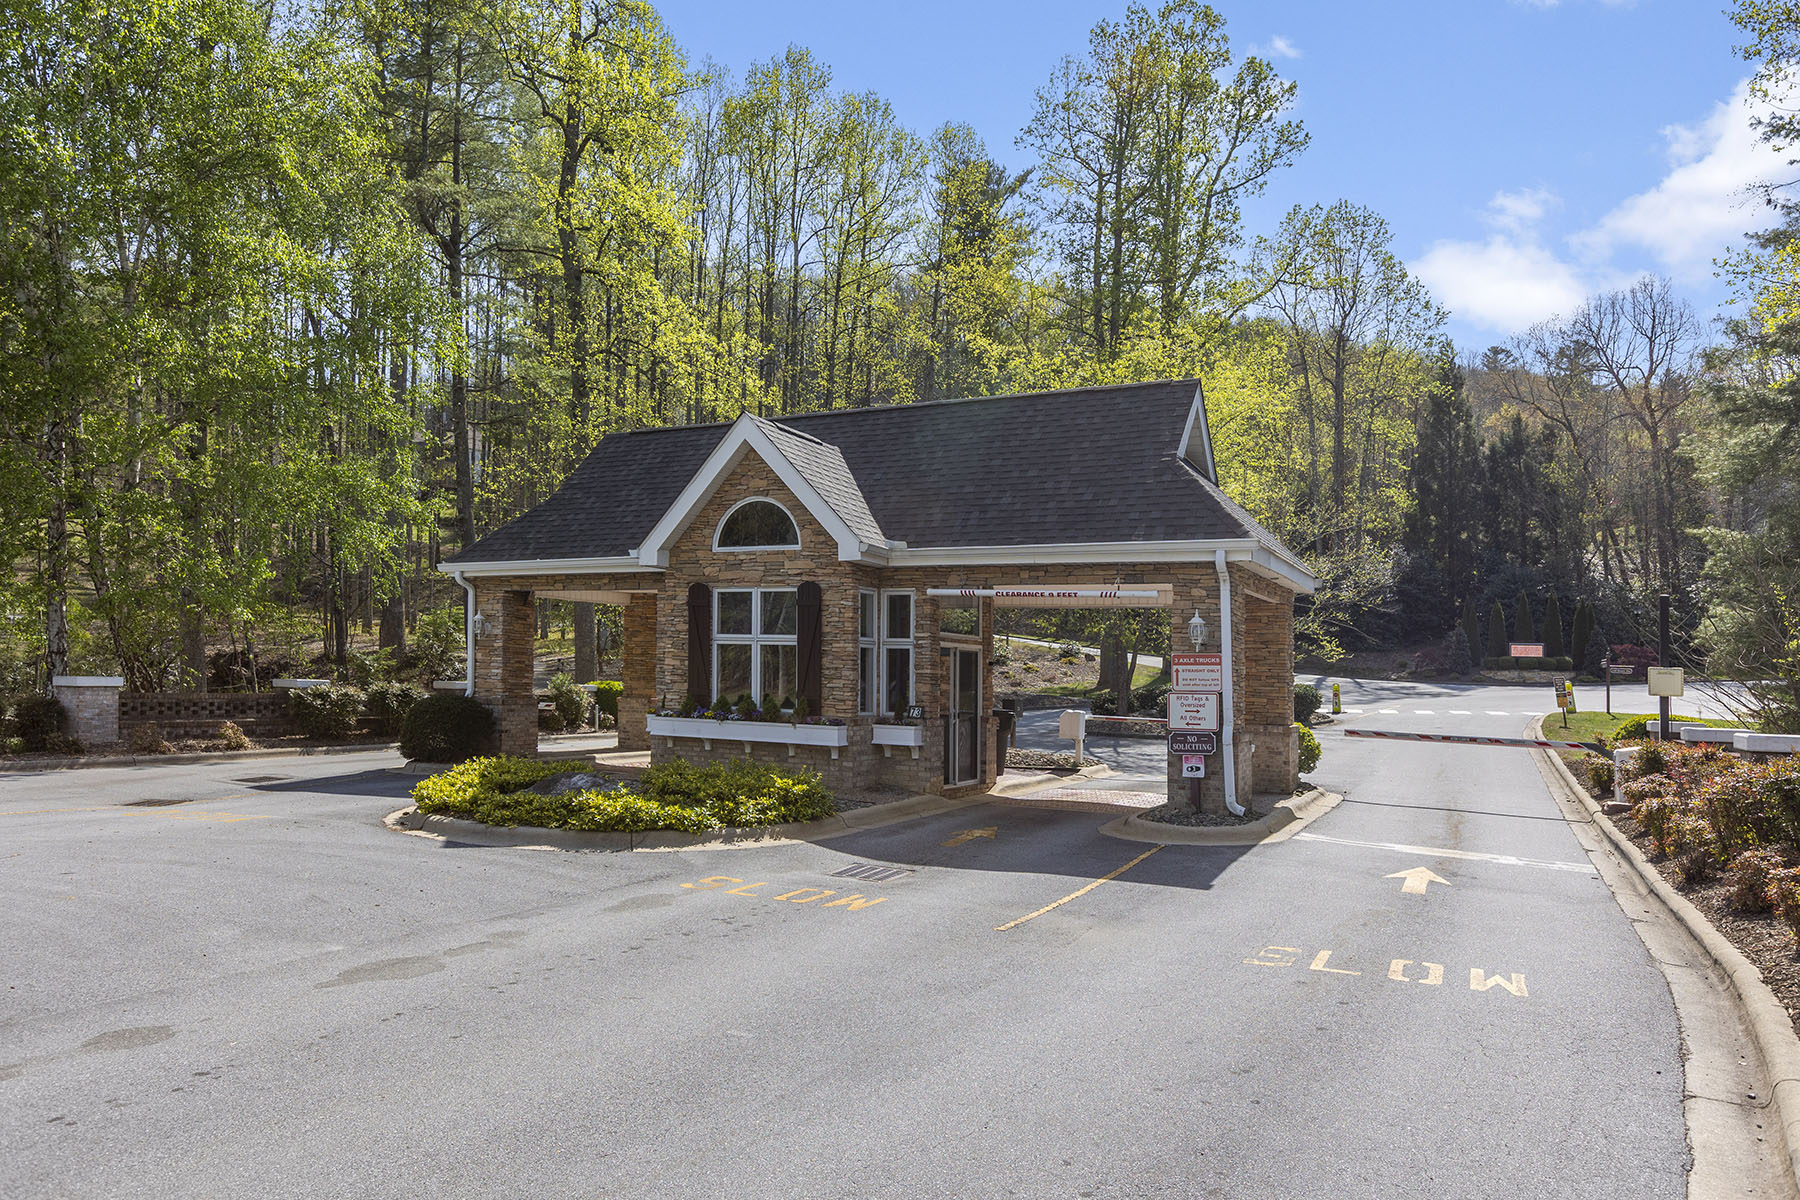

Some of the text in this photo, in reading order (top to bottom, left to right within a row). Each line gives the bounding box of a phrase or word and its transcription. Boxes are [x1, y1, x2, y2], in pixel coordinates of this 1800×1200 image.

[910, 707, 921, 717] 73
[679, 876, 888, 911] SLOW
[1242, 946, 1529, 997] SLOW
